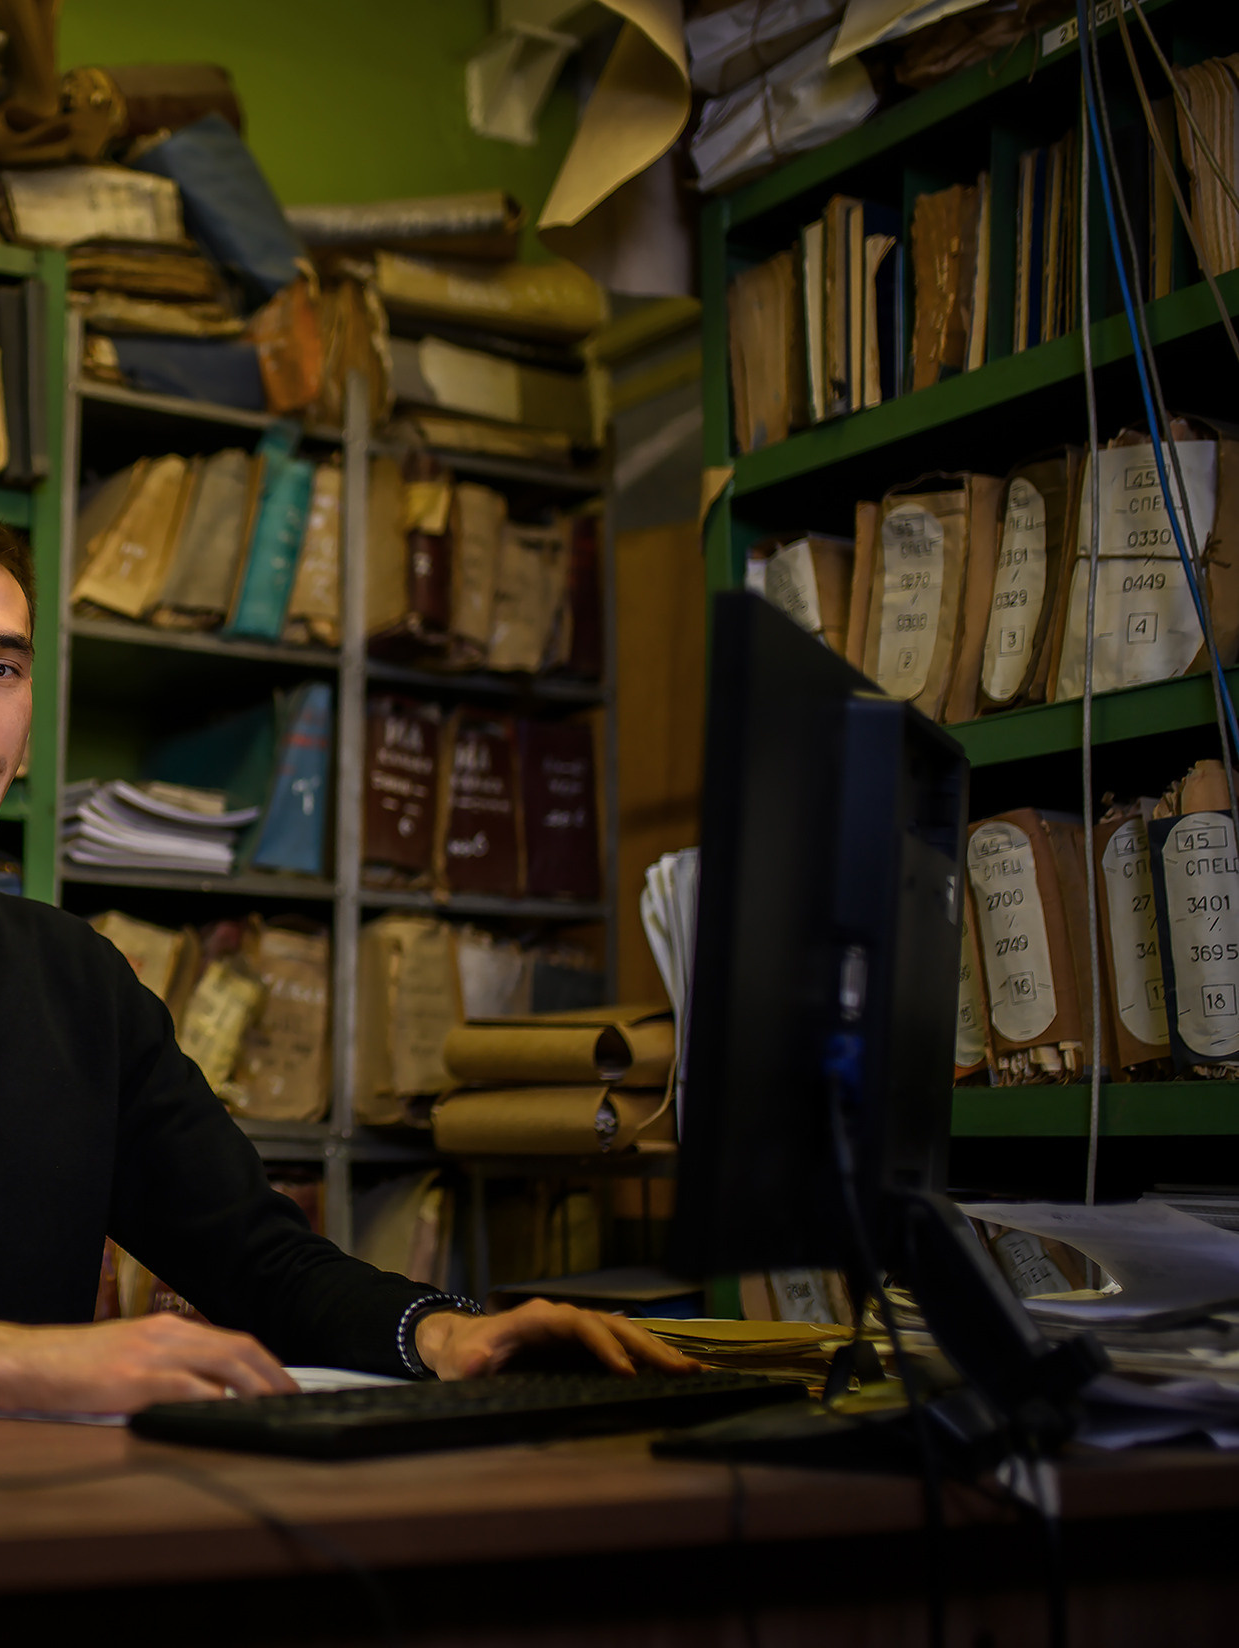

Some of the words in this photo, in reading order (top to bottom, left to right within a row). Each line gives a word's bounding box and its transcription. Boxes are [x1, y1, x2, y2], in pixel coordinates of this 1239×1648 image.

[1132, 470, 1156, 488] 45
[1128, 528, 1172, 548] 0330
[1123, 573, 1166, 593] 0449
[1135, 619, 1148, 635] 4
[1183, 831, 1210, 850] 45
[983, 859, 1024, 882] СПЕЦ
[1123, 861, 1152, 879] СП
[986, 888, 1025, 912] 2700
[1132, 894, 1152, 912] 27
[1187, 895, 1232, 914] 3401
[995, 934, 1029, 958] 2749
[1136, 942, 1157, 960] 34
[1190, 943, 1239, 963] 3695
[1013, 978, 1032, 996] 16
[1206, 992, 1226, 1010] 18
